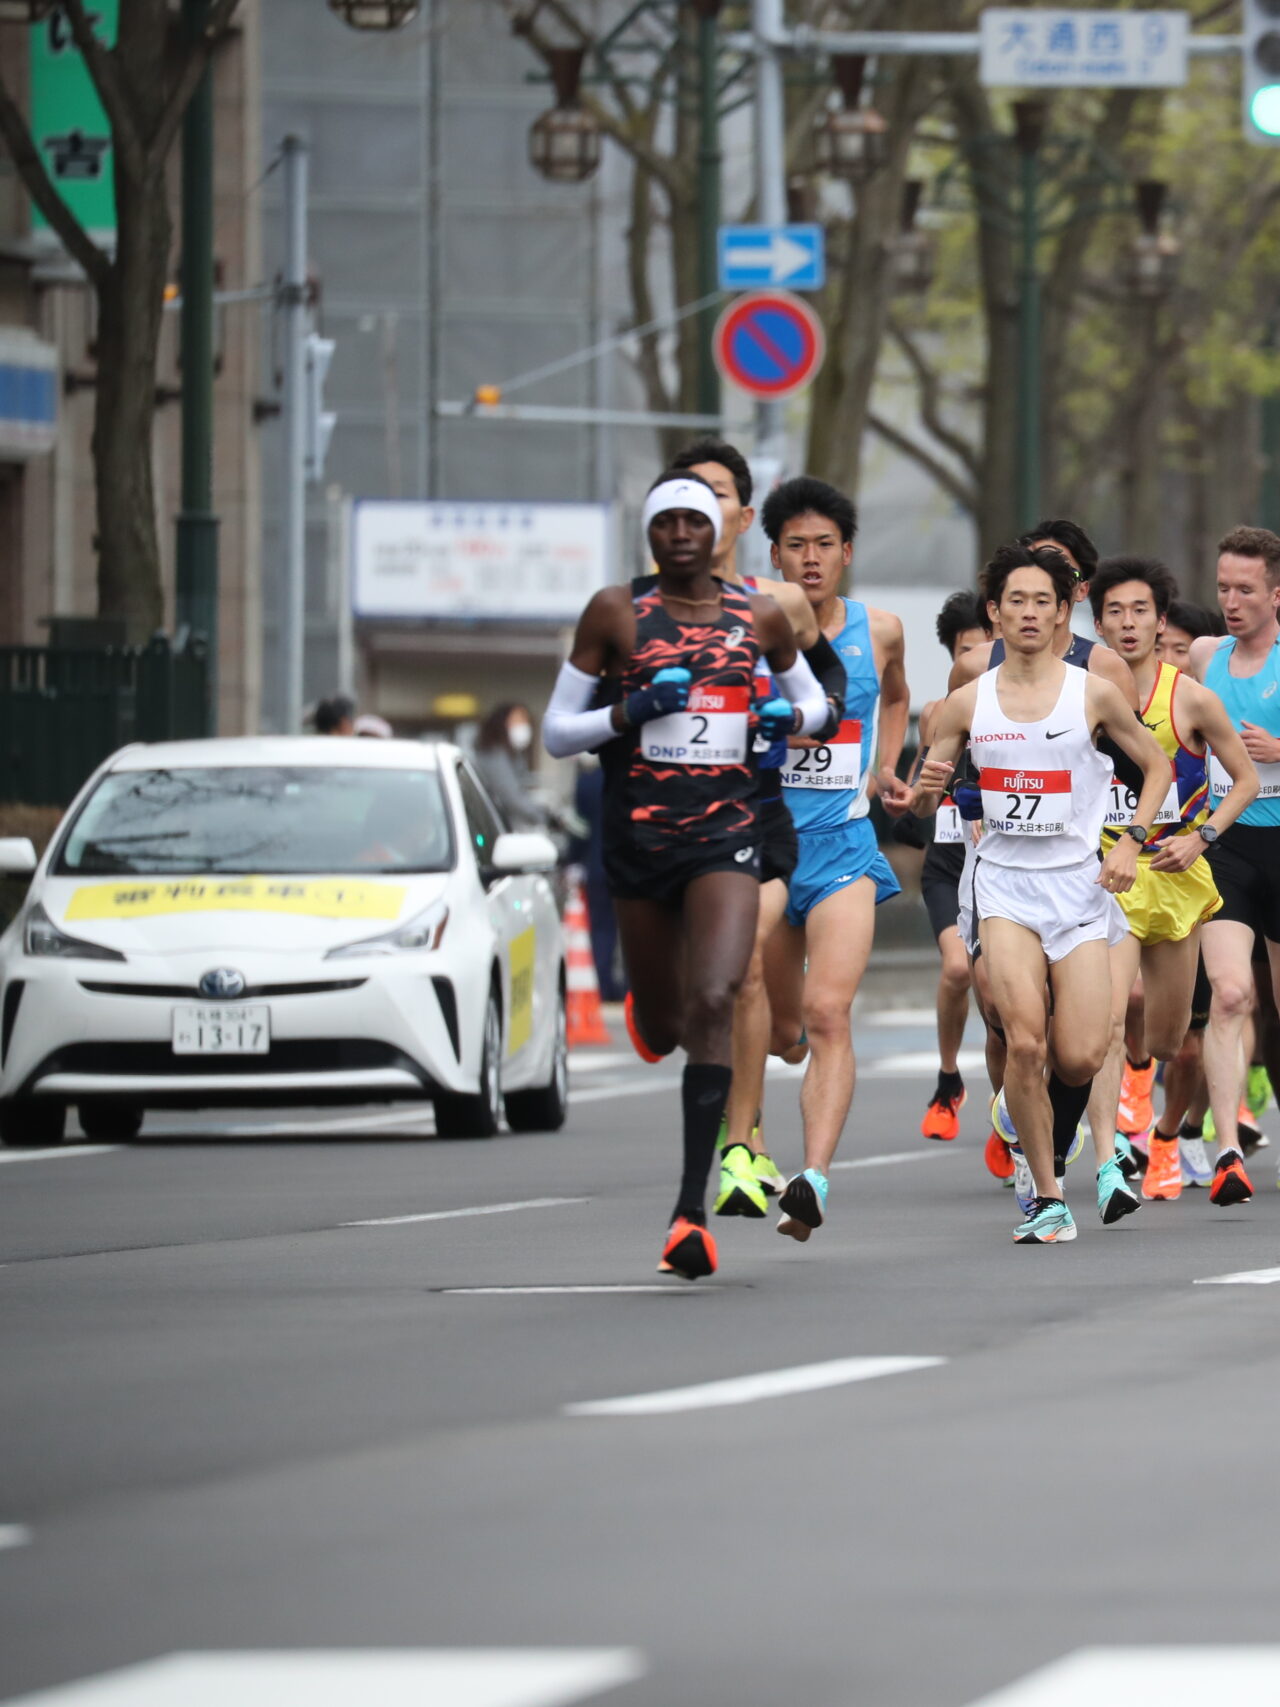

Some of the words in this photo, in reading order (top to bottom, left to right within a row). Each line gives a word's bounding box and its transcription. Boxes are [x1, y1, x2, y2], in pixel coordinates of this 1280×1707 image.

[689, 715, 709, 744] 2
[974, 732, 1027, 744] HONDA
[649, 745, 687, 758] DNP
[792, 745, 832, 772] 29
[805, 774, 853, 785] 大日本印刷
[1003, 771, 1044, 792] FUJITSU
[1006, 793, 1042, 821] 27
[989, 819, 1014, 832] DNP
[1017, 822, 1065, 833] 大日本印刷
